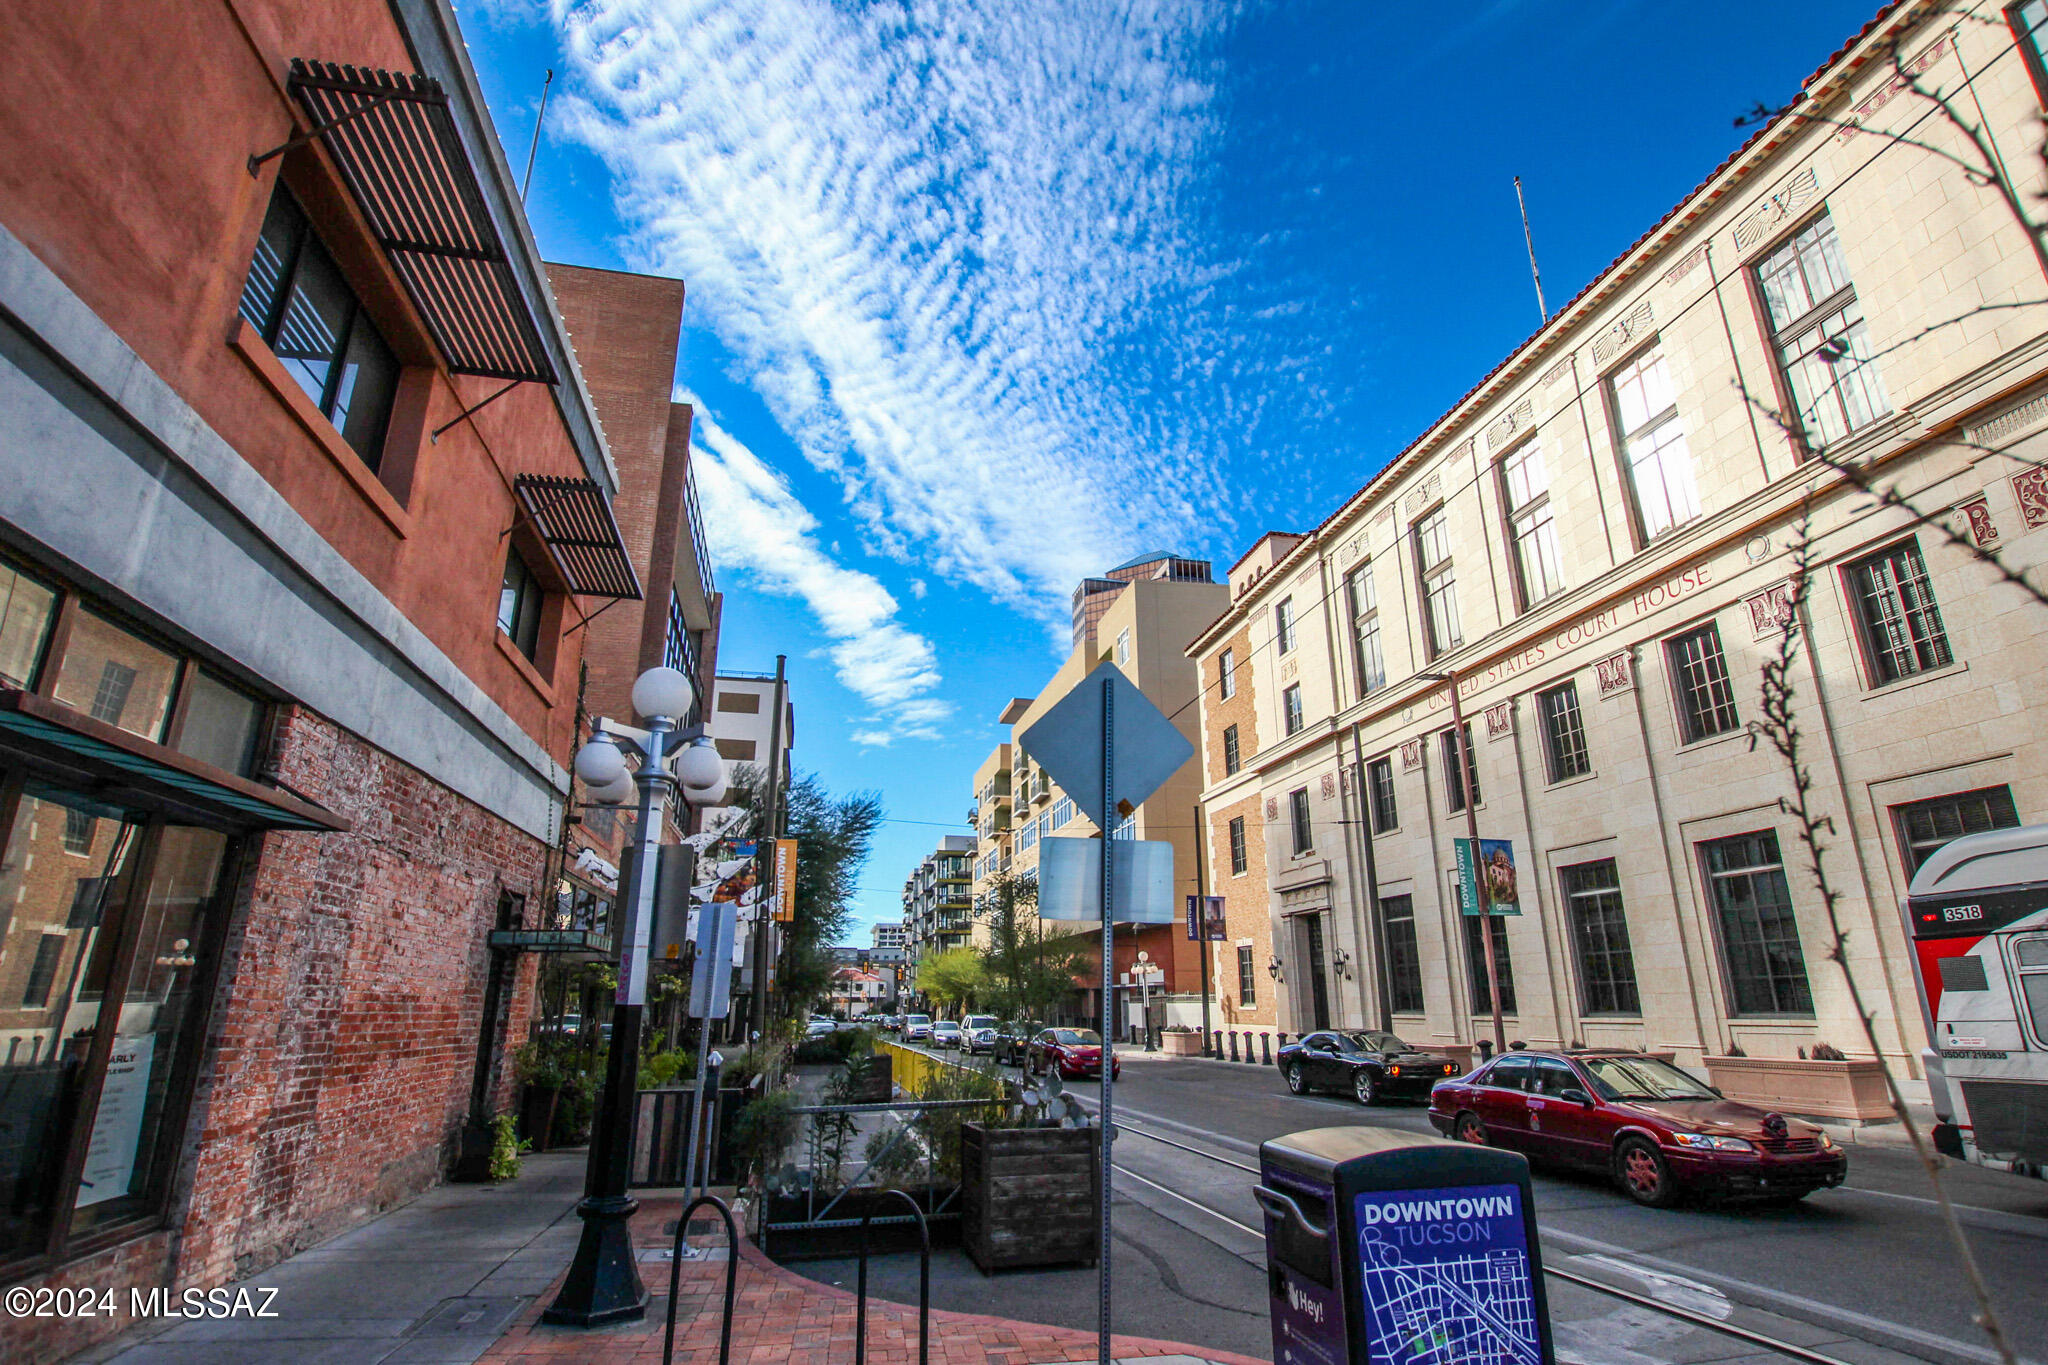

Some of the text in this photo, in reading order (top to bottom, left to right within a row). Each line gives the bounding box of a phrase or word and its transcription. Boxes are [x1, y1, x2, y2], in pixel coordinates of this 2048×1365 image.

[1428, 561, 1712, 710] UNIED STATES COURT HOUSE
[777, 847, 787, 913] DOWNTOWN
[1456, 845, 1470, 908] DOWNTOWN
[1945, 906, 1980, 921] 3518
[1941, 1051, 1971, 1060] USDOT
[1364, 1195, 1514, 1225] DOWNTOWN
[1394, 1220, 1491, 1247] TUCSON
[1299, 1289, 1325, 1324] Hey!
